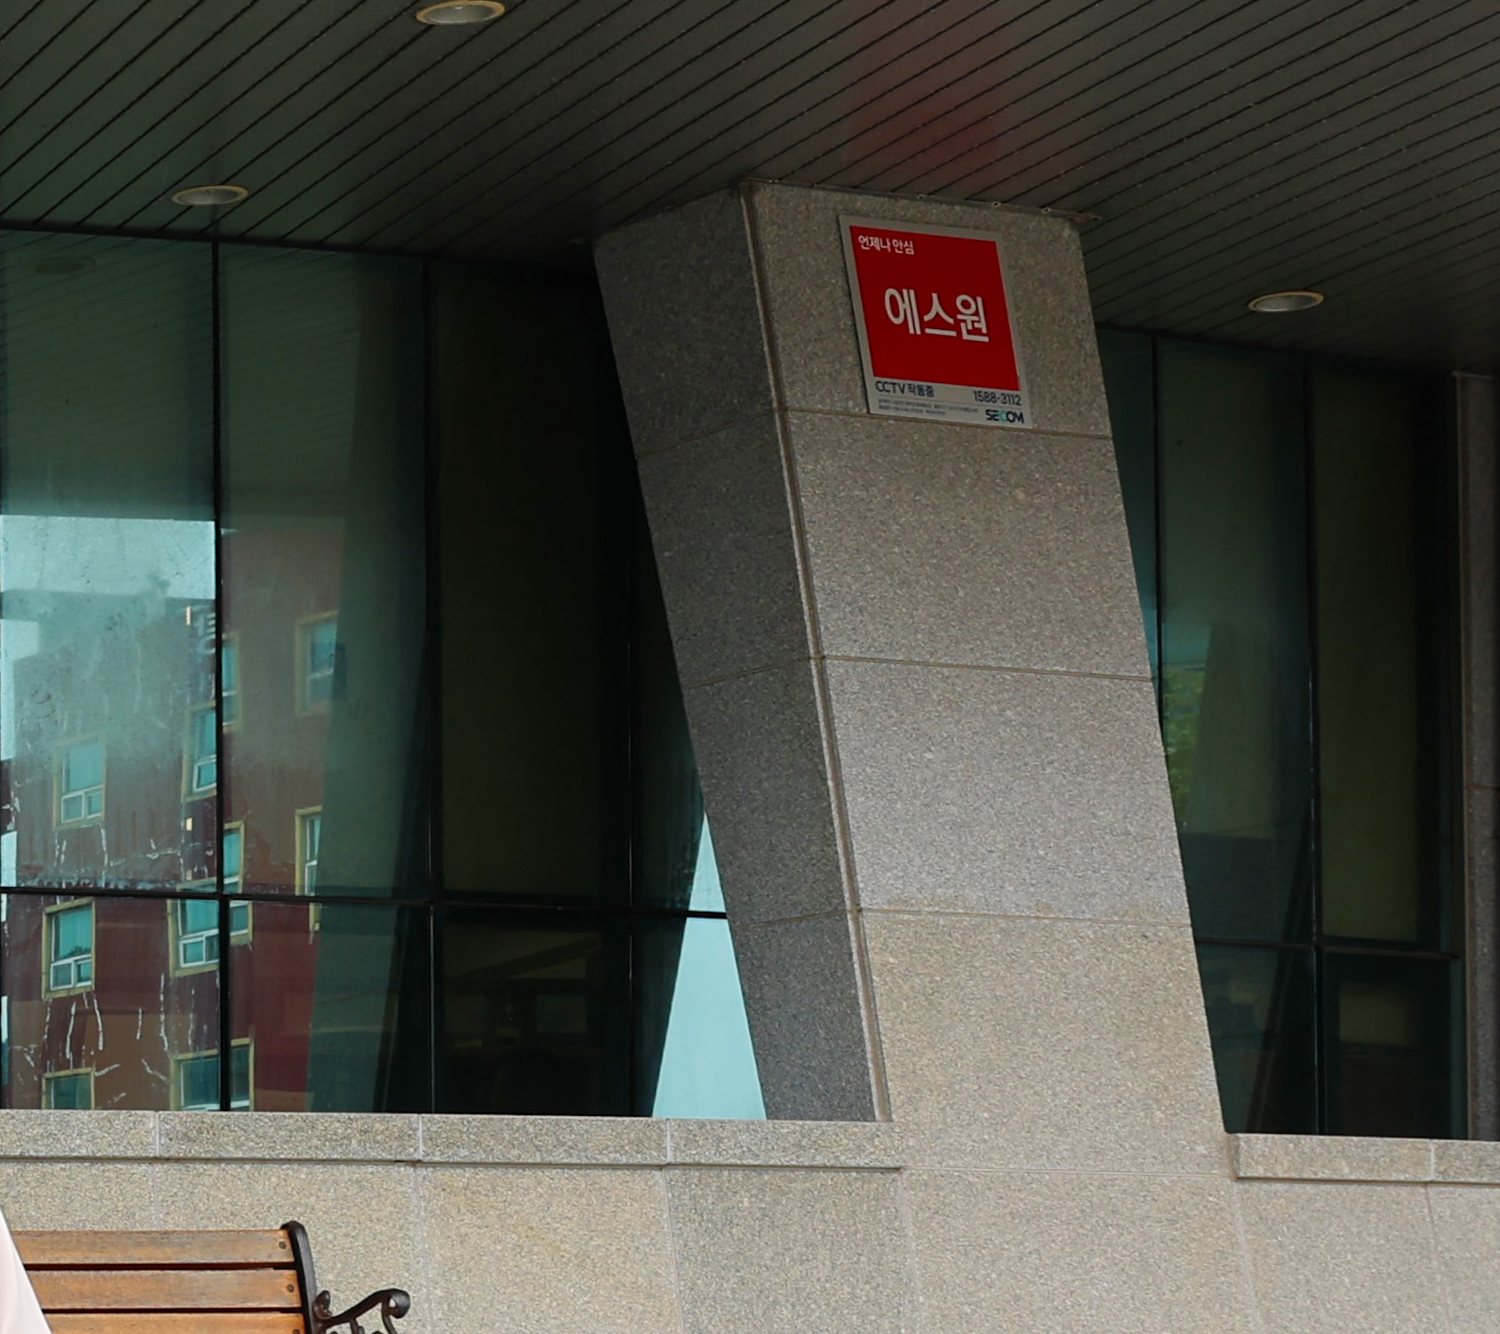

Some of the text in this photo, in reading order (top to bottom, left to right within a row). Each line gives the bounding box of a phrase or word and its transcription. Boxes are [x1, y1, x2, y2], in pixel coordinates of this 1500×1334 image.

[858, 235, 915, 255] 언제나 안심
[884, 287, 990, 343] 에스원
[875, 380, 906, 394] CCTV
[972, 389, 1022, 407] 1588-3112
[985, 408, 1025, 424] SECOM
